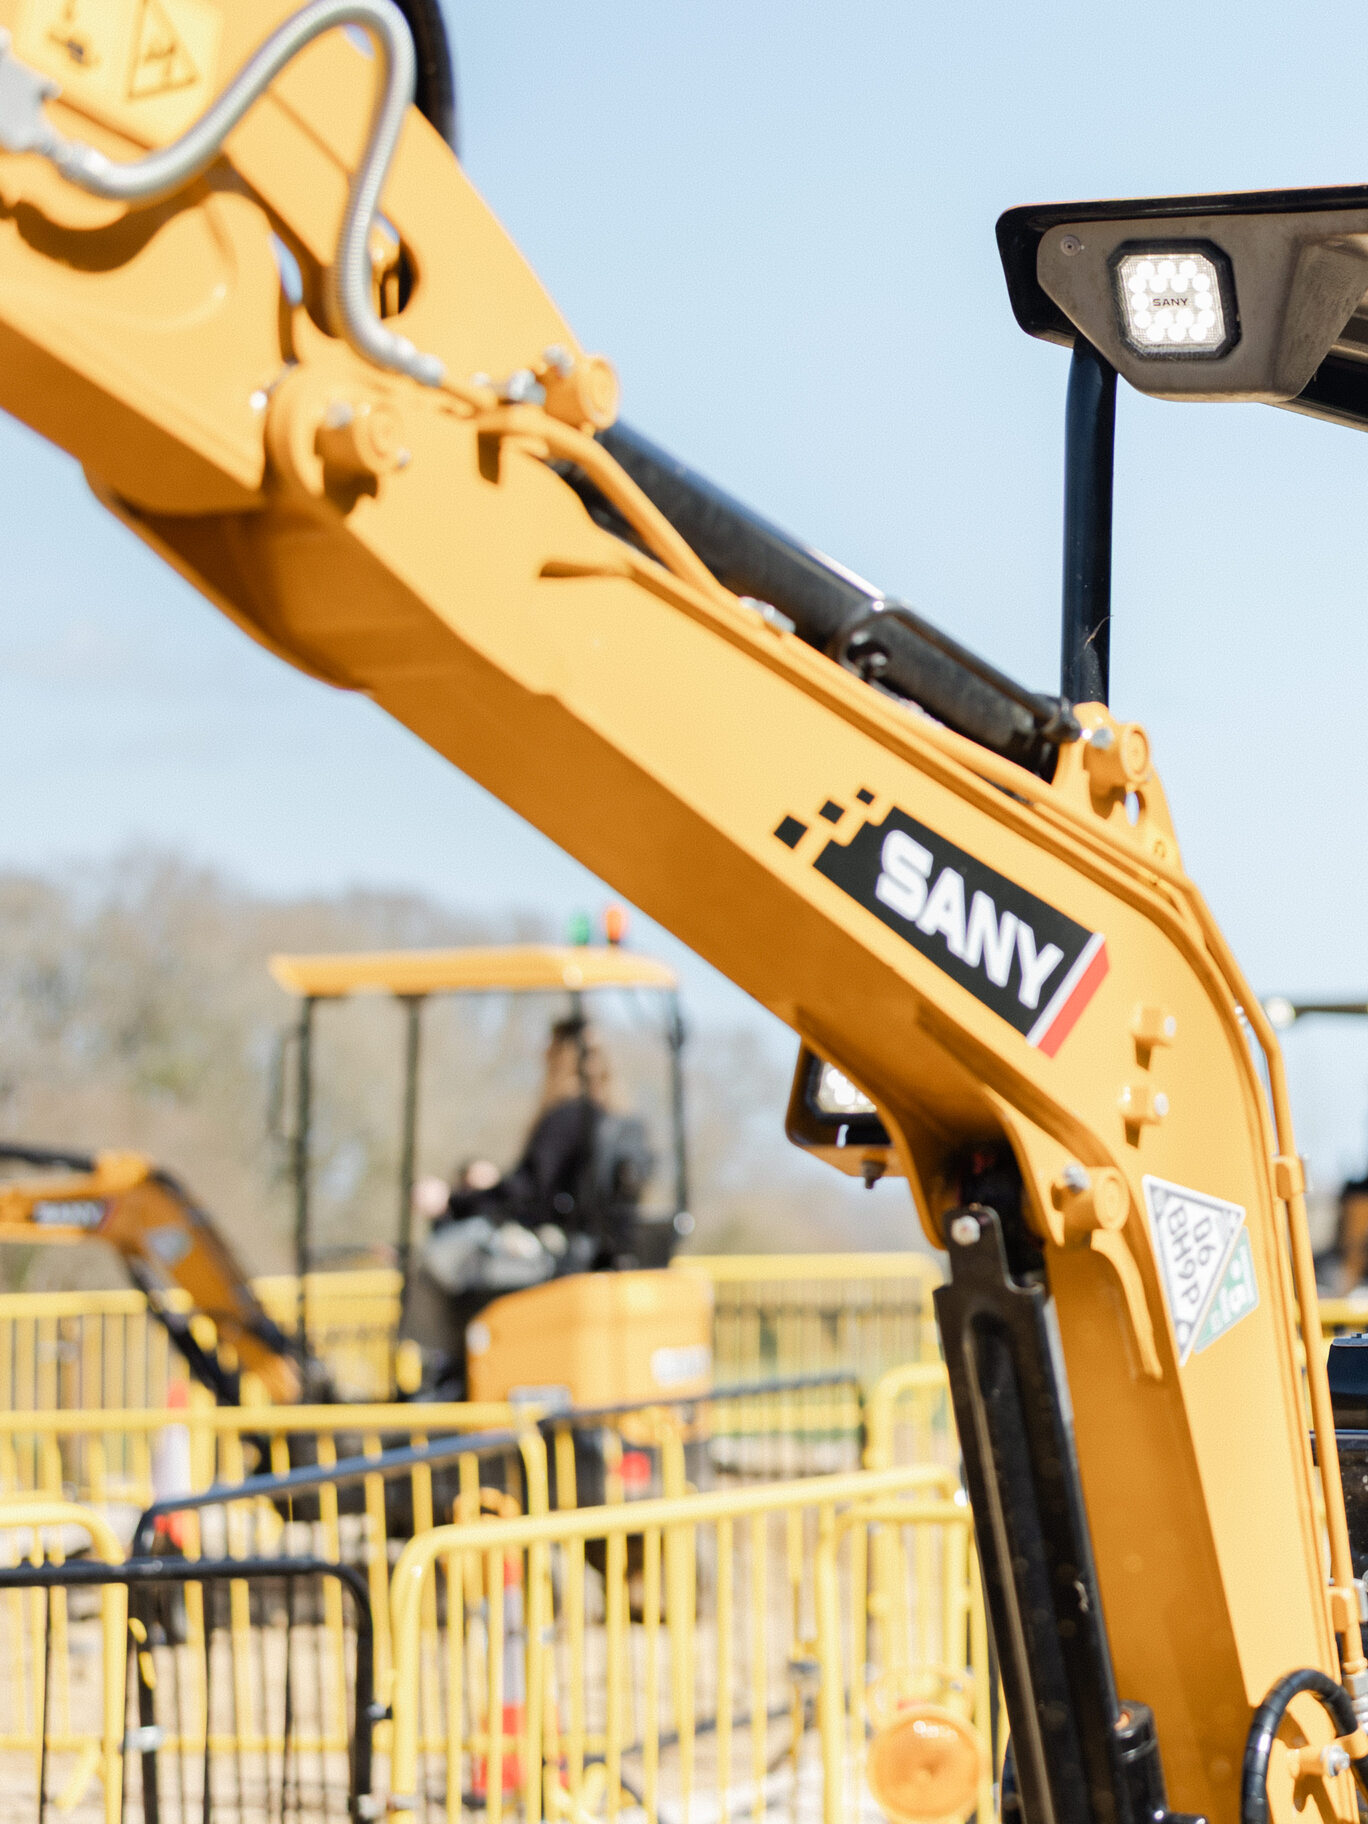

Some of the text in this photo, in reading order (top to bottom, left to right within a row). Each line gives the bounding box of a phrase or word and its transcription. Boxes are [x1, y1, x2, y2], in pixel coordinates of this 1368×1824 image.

[1151, 297, 1188, 307] SANY
[875, 829, 1065, 1010] SANY
[1167, 1205, 1201, 1305] BH9P
